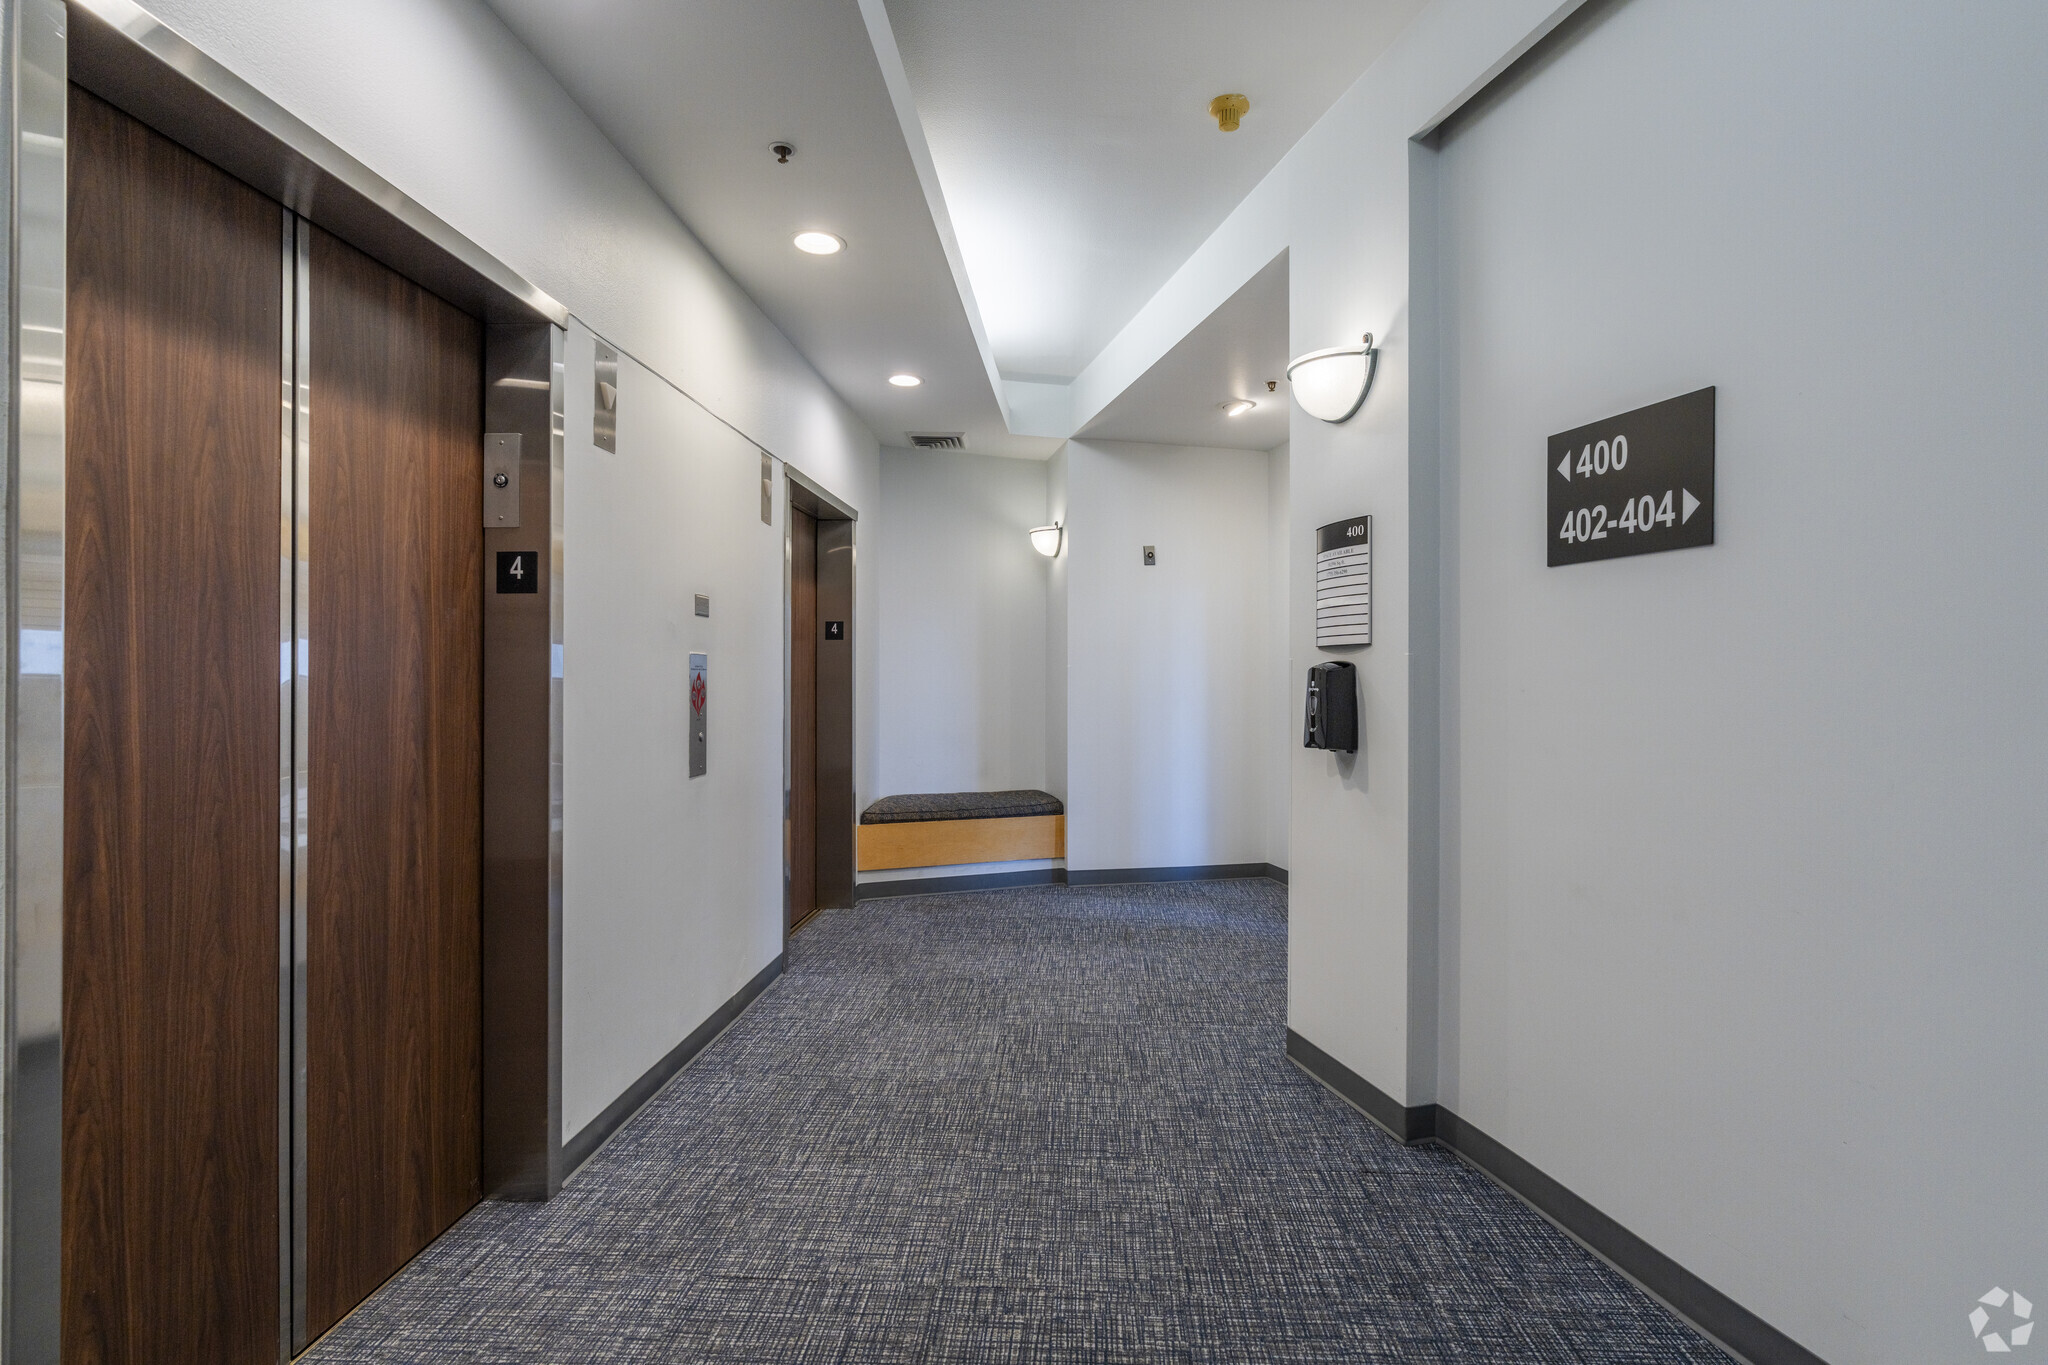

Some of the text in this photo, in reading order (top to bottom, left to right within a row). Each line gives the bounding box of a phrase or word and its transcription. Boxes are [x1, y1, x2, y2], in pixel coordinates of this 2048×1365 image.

[1576, 434, 1628, 479] 400
[1559, 489, 1676, 544] 402-404
[1346, 525, 1364, 537] 400
[509, 555, 524, 579] 4
[831, 623, 838, 634] 4
